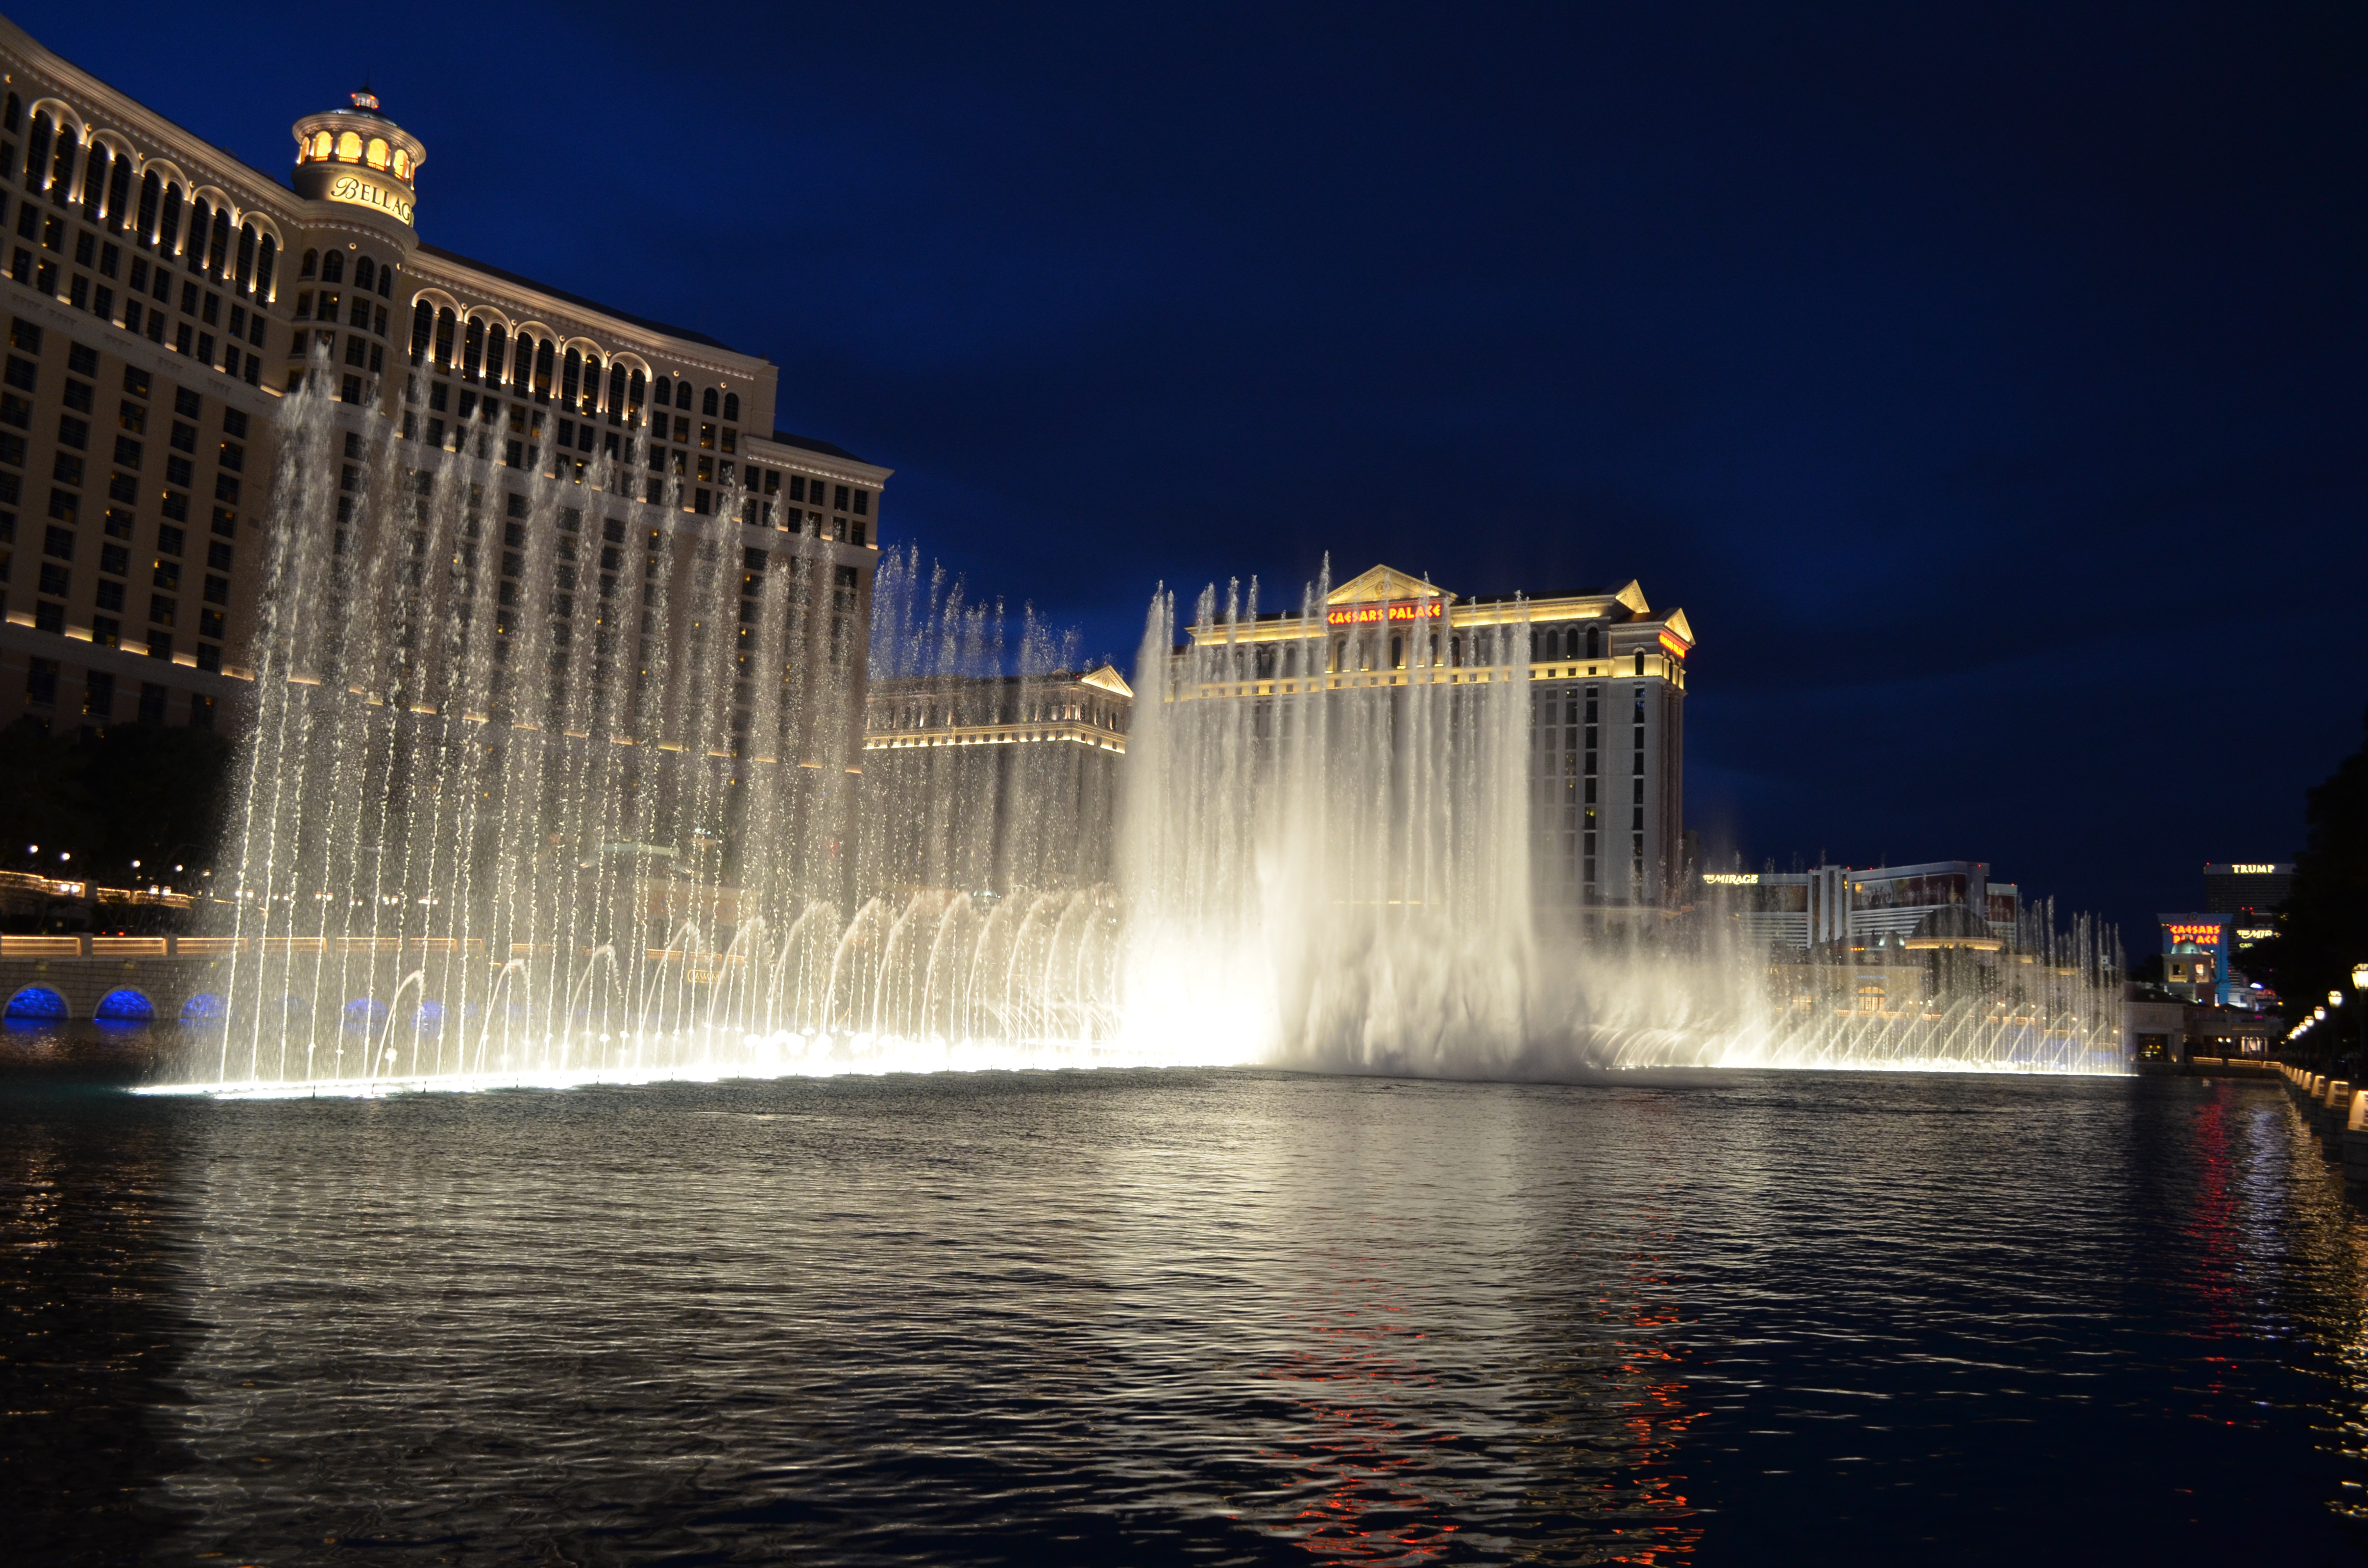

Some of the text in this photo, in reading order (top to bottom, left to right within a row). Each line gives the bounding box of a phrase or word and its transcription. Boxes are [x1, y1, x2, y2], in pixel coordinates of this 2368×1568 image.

[331, 177, 410, 221] BELLAG
[1327, 604, 1441, 625] CAESARS PALACE
[2232, 865, 2274, 873] TRUMP
[1706, 874, 1758, 885] MIRAGE
[2170, 925, 2220, 934] CAESARS
